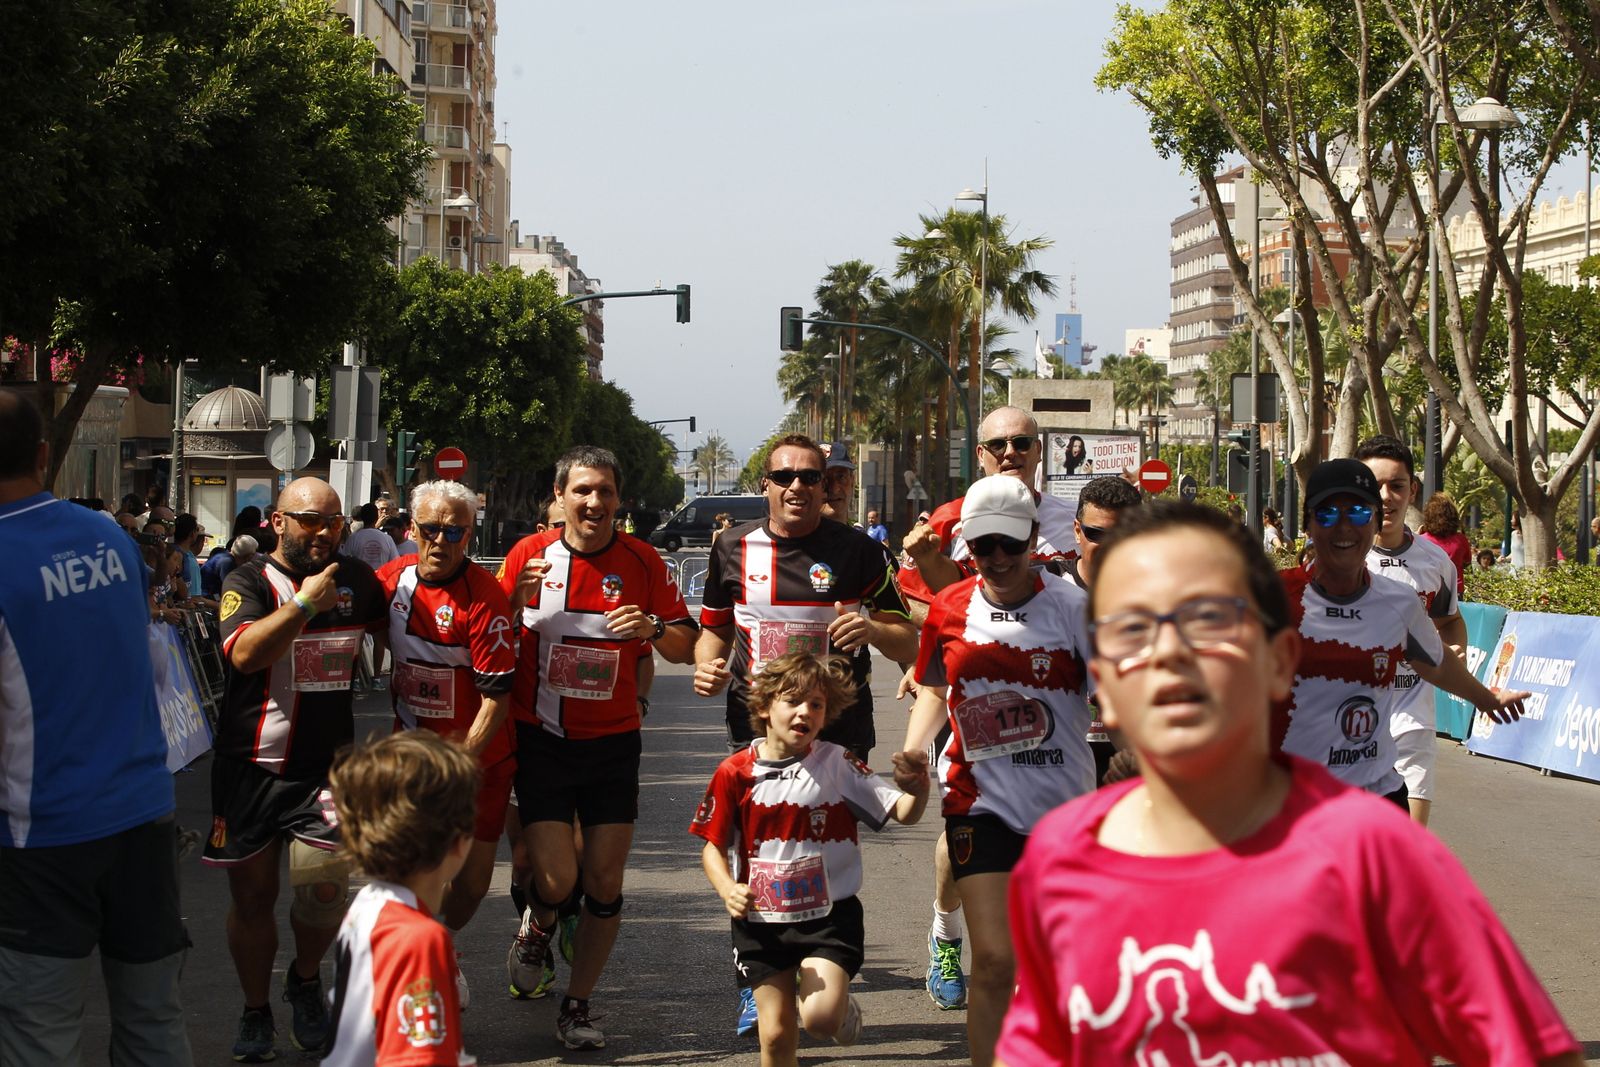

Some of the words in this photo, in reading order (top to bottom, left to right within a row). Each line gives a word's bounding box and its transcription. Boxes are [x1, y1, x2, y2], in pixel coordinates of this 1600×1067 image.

[1093, 445, 1114, 457] TODO
[1116, 442, 1137, 454] TIENE
[52, 550, 76, 561] GRUPO
[1380, 559, 1408, 568] BLK
[991, 612, 1028, 622] BLK
[1326, 607, 1362, 620] BLK
[1513, 655, 1576, 687] AYUNTAMIENTO
[419, 682, 440, 699] 84
[994, 704, 1036, 730] 175
[1327, 740, 1378, 766] lamarca
[771, 874, 823, 899] 1911
